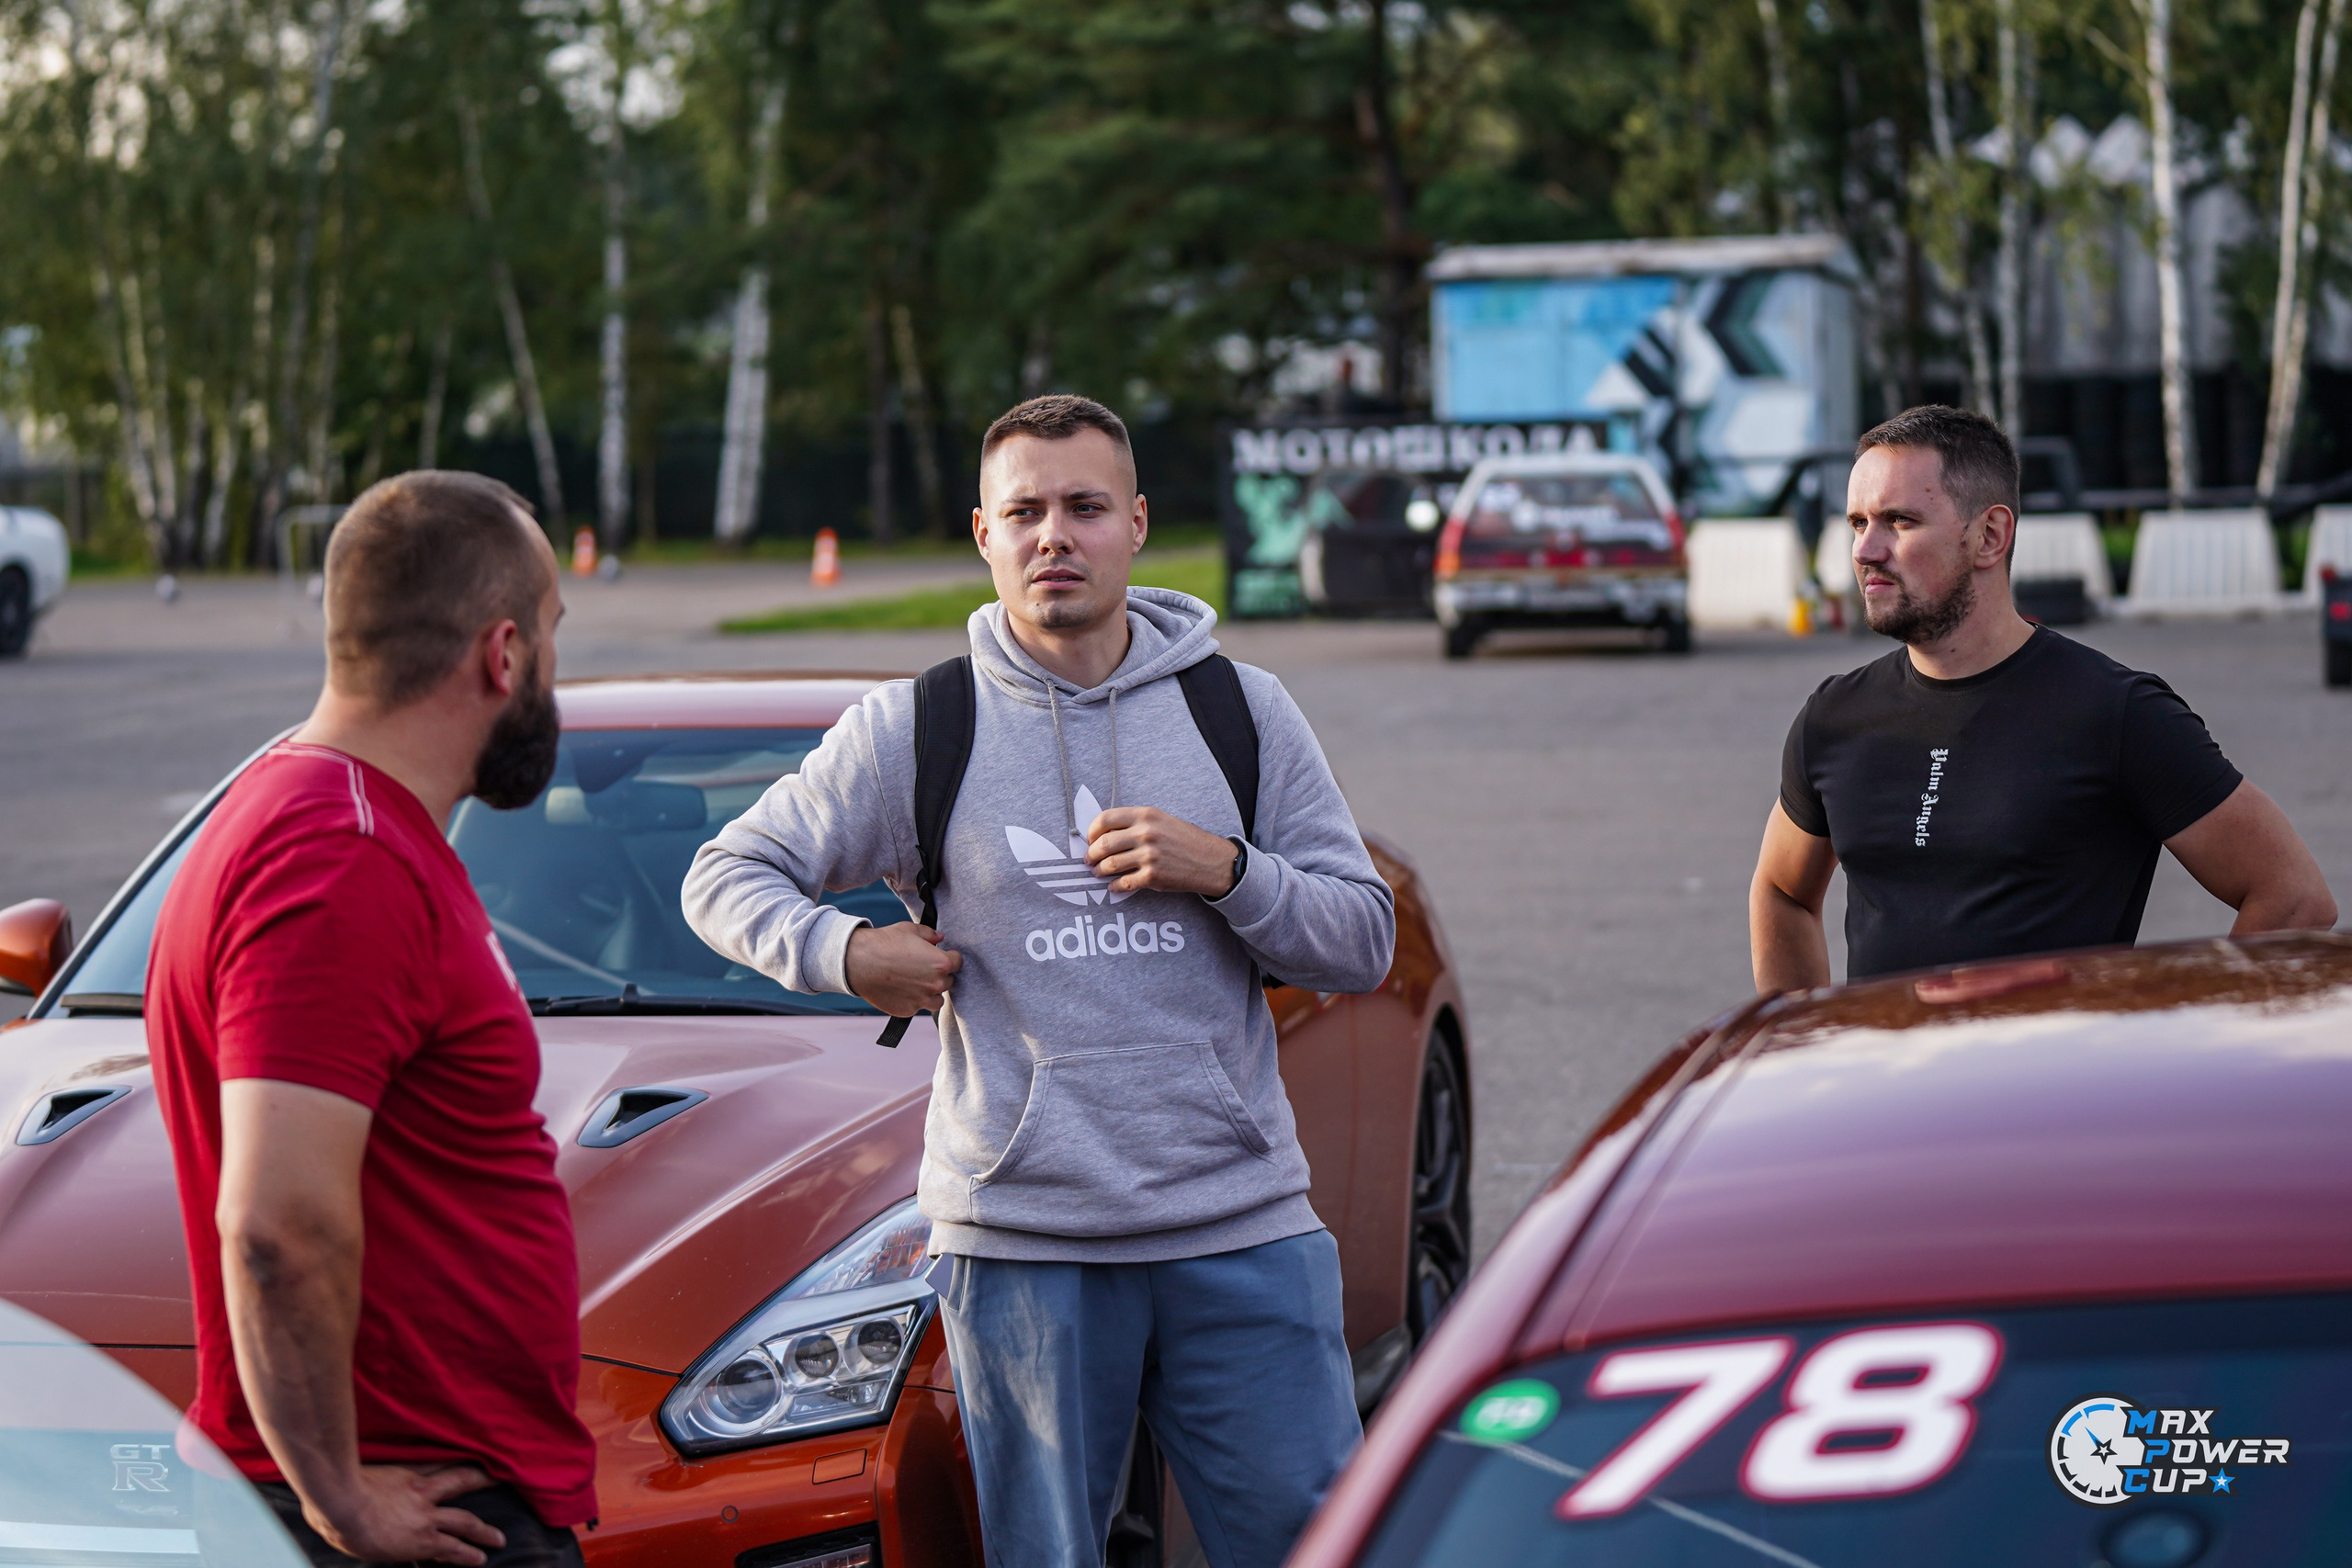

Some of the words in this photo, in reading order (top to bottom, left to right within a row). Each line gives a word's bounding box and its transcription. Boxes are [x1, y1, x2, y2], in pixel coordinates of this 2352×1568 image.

[1928, 748, 1949, 791] Palm
[1915, 793, 1939, 847] Angels
[1025, 913, 1185, 961] adidas
[1555, 1321, 2004, 1518] 78
[110, 1443, 171, 1460] GT
[111, 1461, 171, 1492] R
